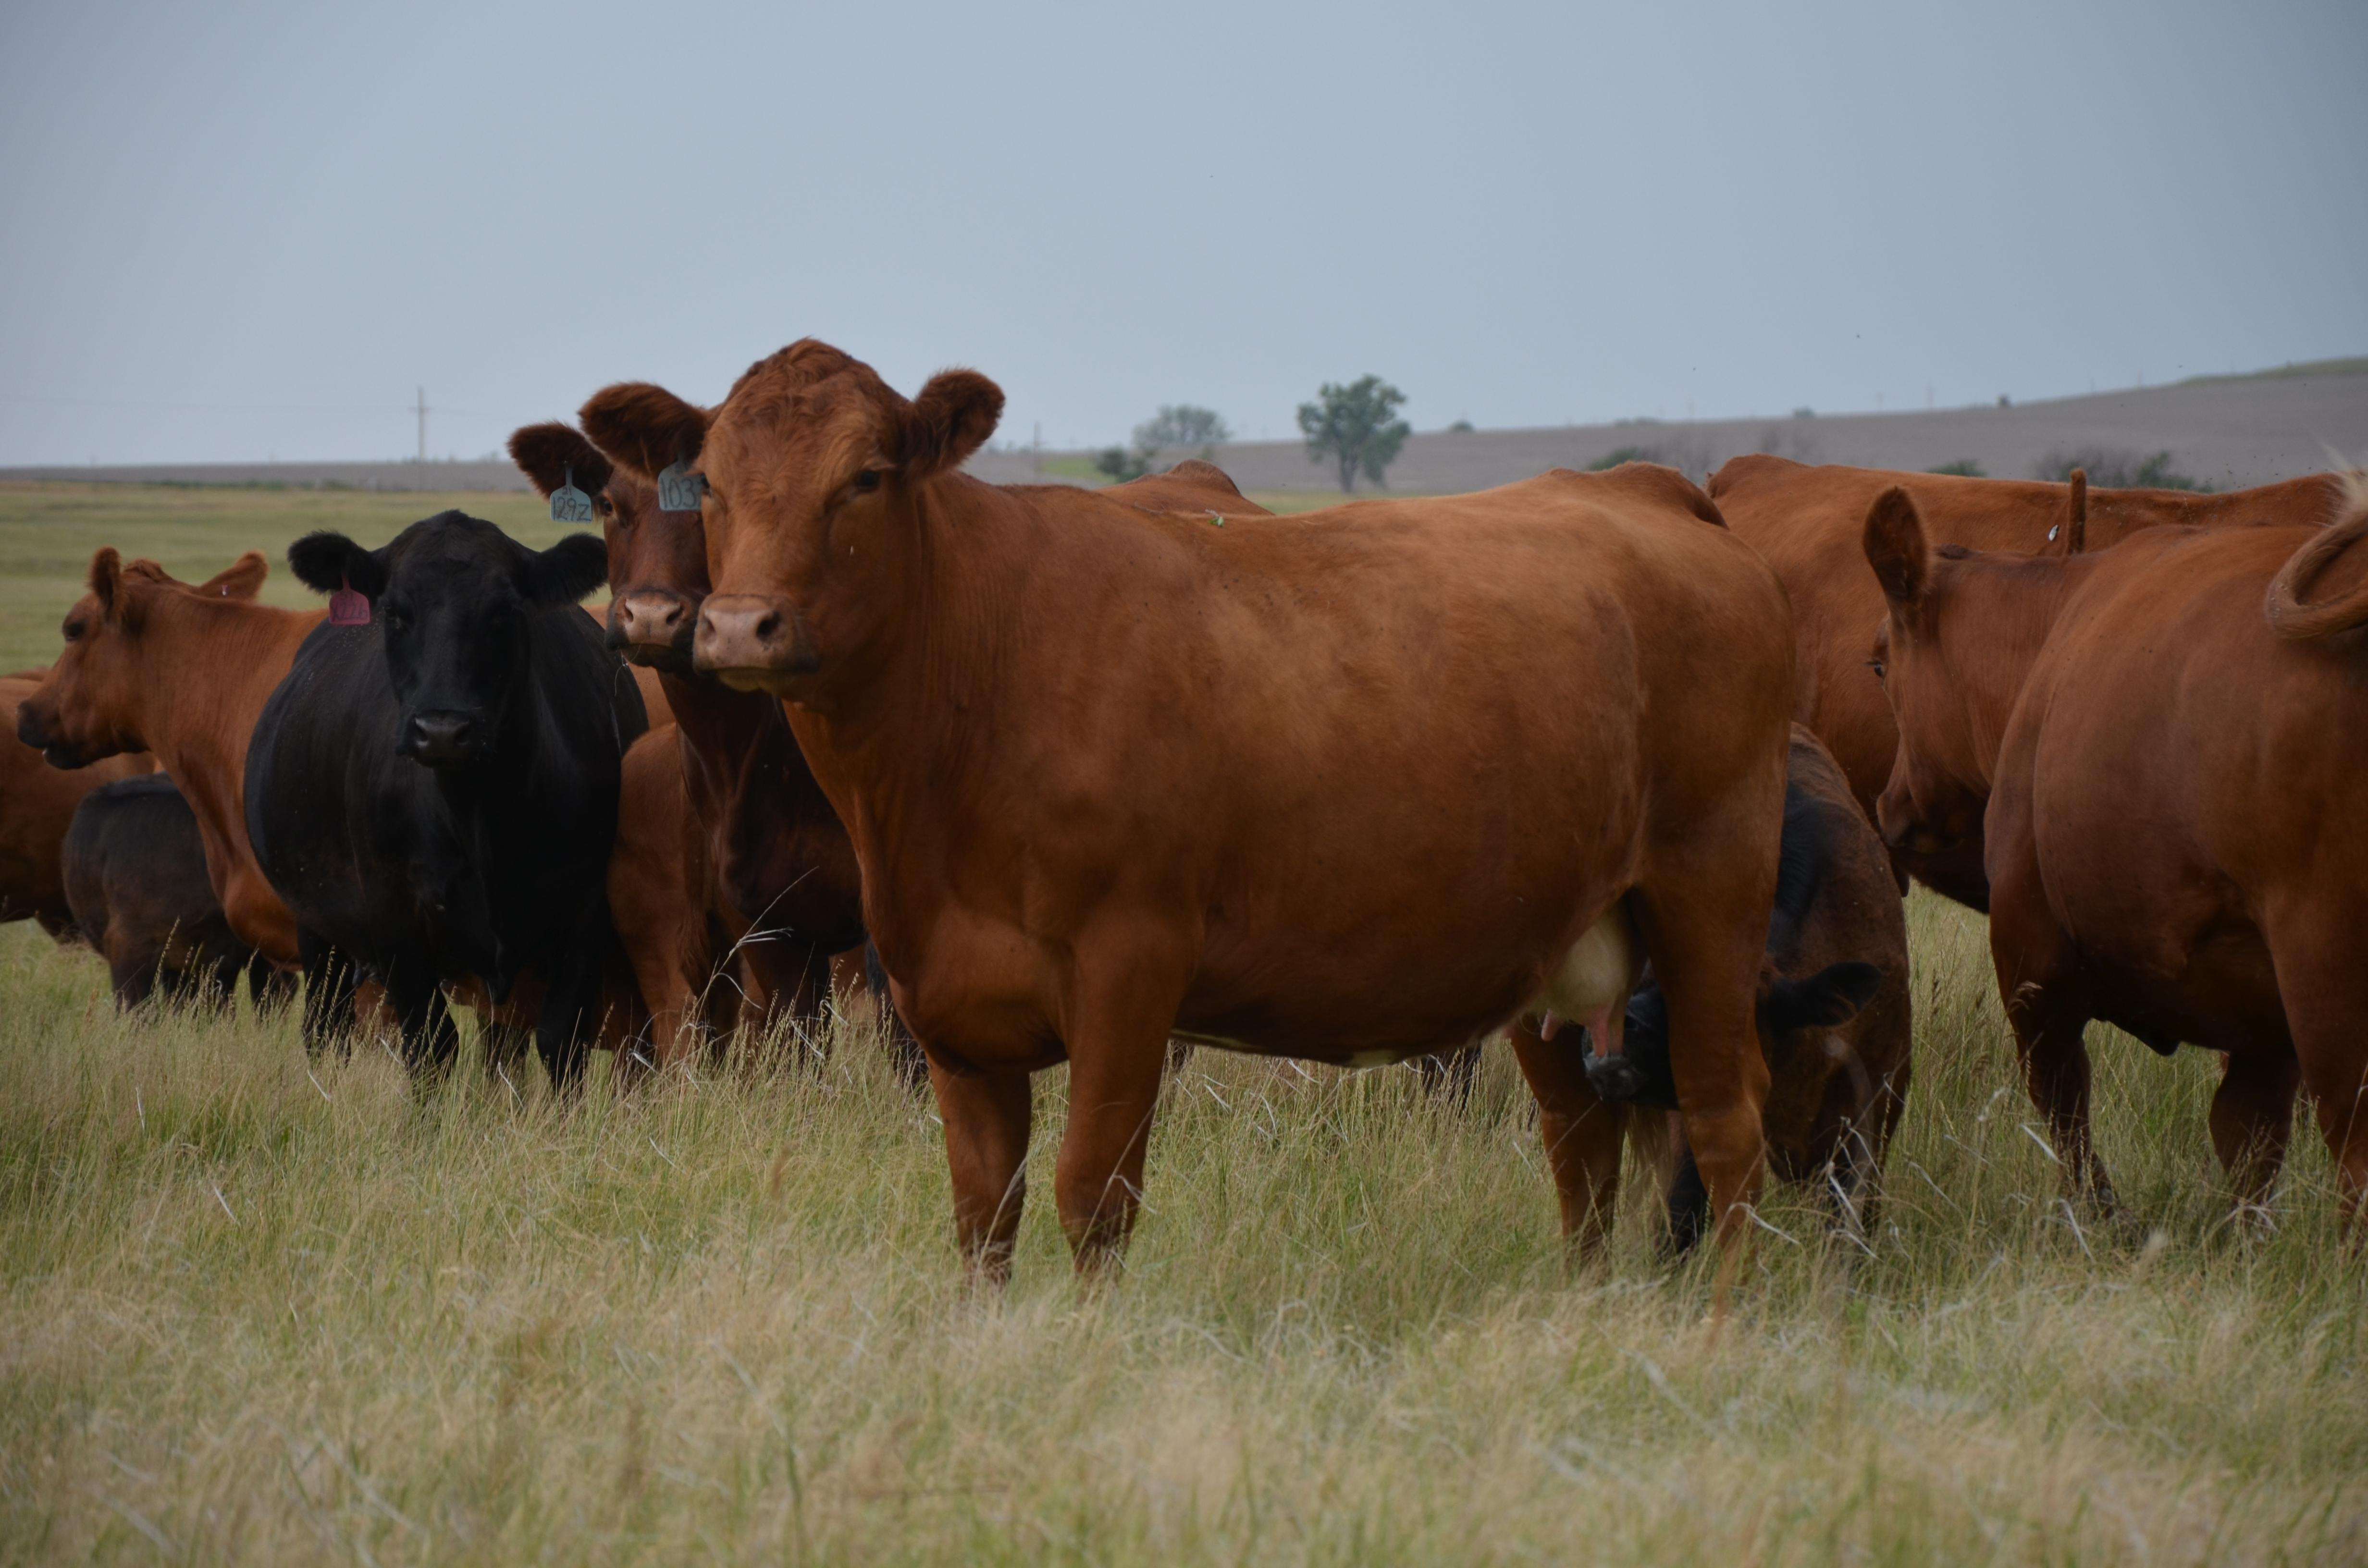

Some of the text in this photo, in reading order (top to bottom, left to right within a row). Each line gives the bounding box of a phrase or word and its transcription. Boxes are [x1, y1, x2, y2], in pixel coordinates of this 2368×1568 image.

[562, 487, 572, 495] 21
[660, 477, 702, 508] 103
[553, 496, 591, 521] 129Z
